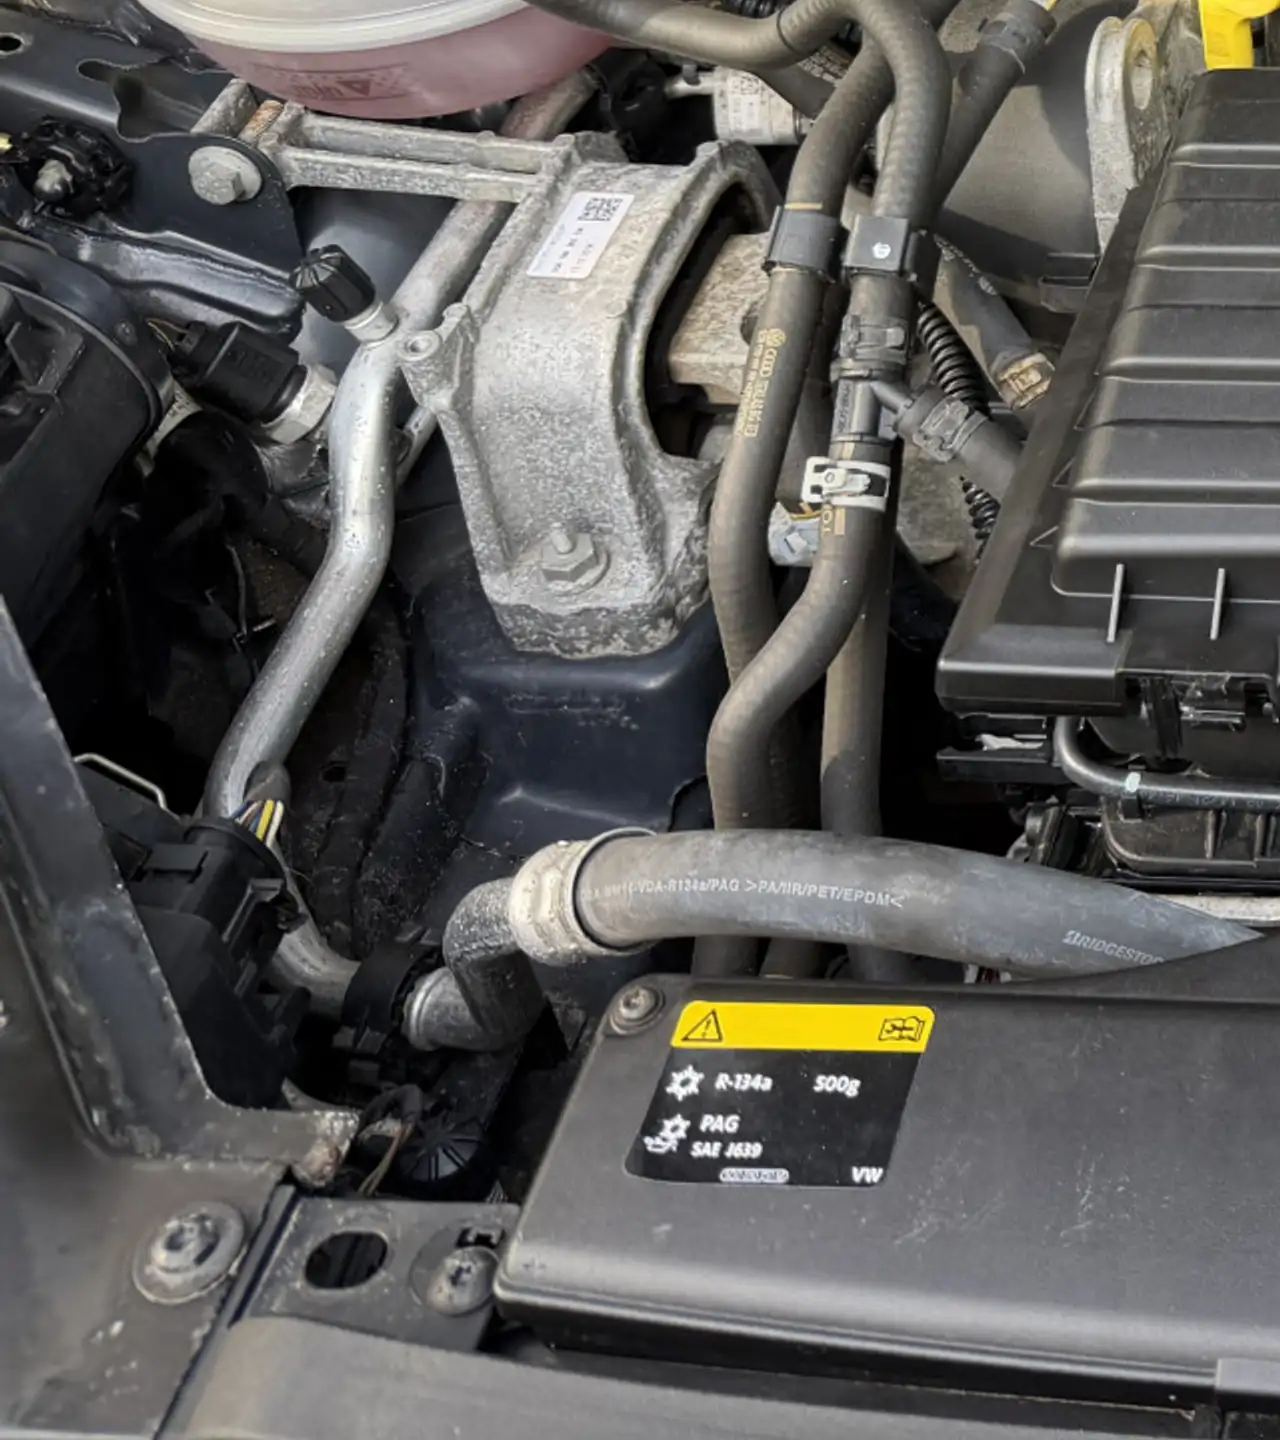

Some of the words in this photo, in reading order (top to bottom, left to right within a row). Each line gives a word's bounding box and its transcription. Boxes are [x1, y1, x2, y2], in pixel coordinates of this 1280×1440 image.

[714, 1072, 773, 1093] R-134a
[813, 1074, 862, 1098] 500g
[699, 1113, 740, 1134] PAG
[690, 1140, 720, 1158] SAE
[724, 1141, 763, 1159] J639
[851, 1166, 883, 1184] VW
